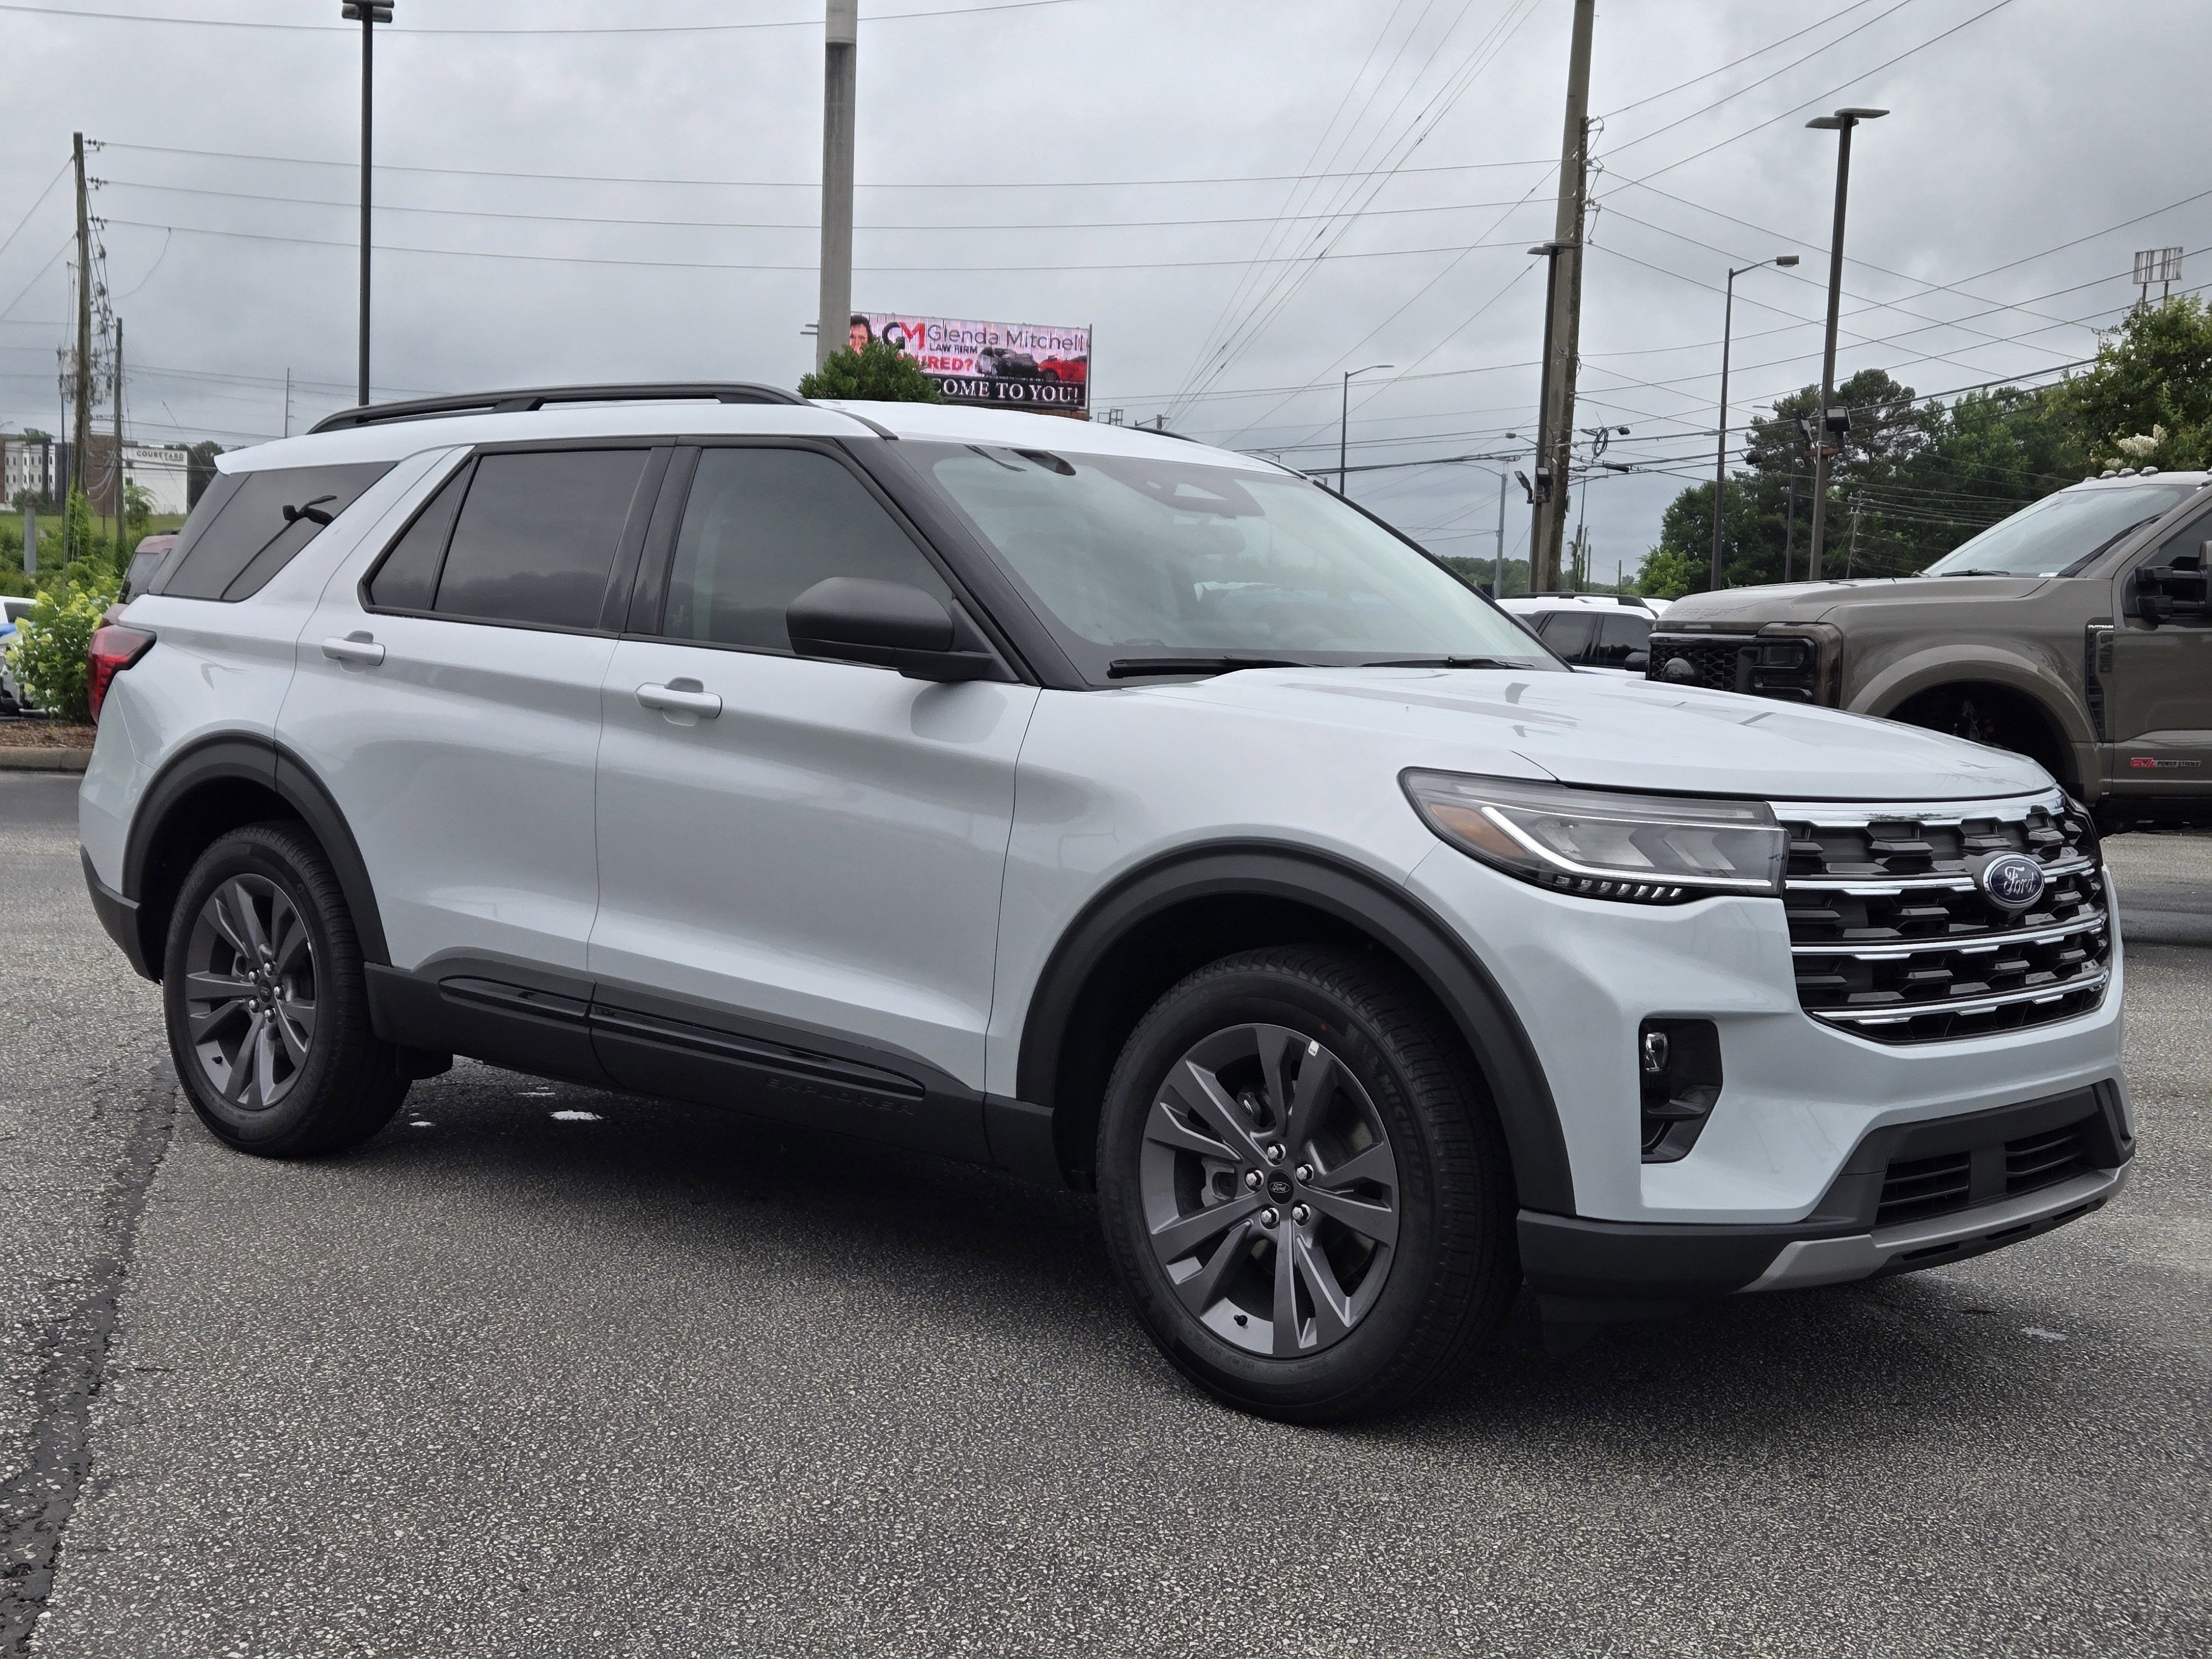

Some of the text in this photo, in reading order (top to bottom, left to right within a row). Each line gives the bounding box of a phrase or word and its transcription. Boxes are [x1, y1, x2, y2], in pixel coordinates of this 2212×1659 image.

[927, 324, 1083, 352] Glenda Mitchell
[930, 343, 978, 354] LAW FIRM
[996, 382, 1024, 399] TO
[1029, 384, 1078, 404] YOU!
[136, 450, 184, 459] COURTYARD
[2004, 866, 2036, 895] Ford
[1272, 1183, 1286, 1191] Ford
